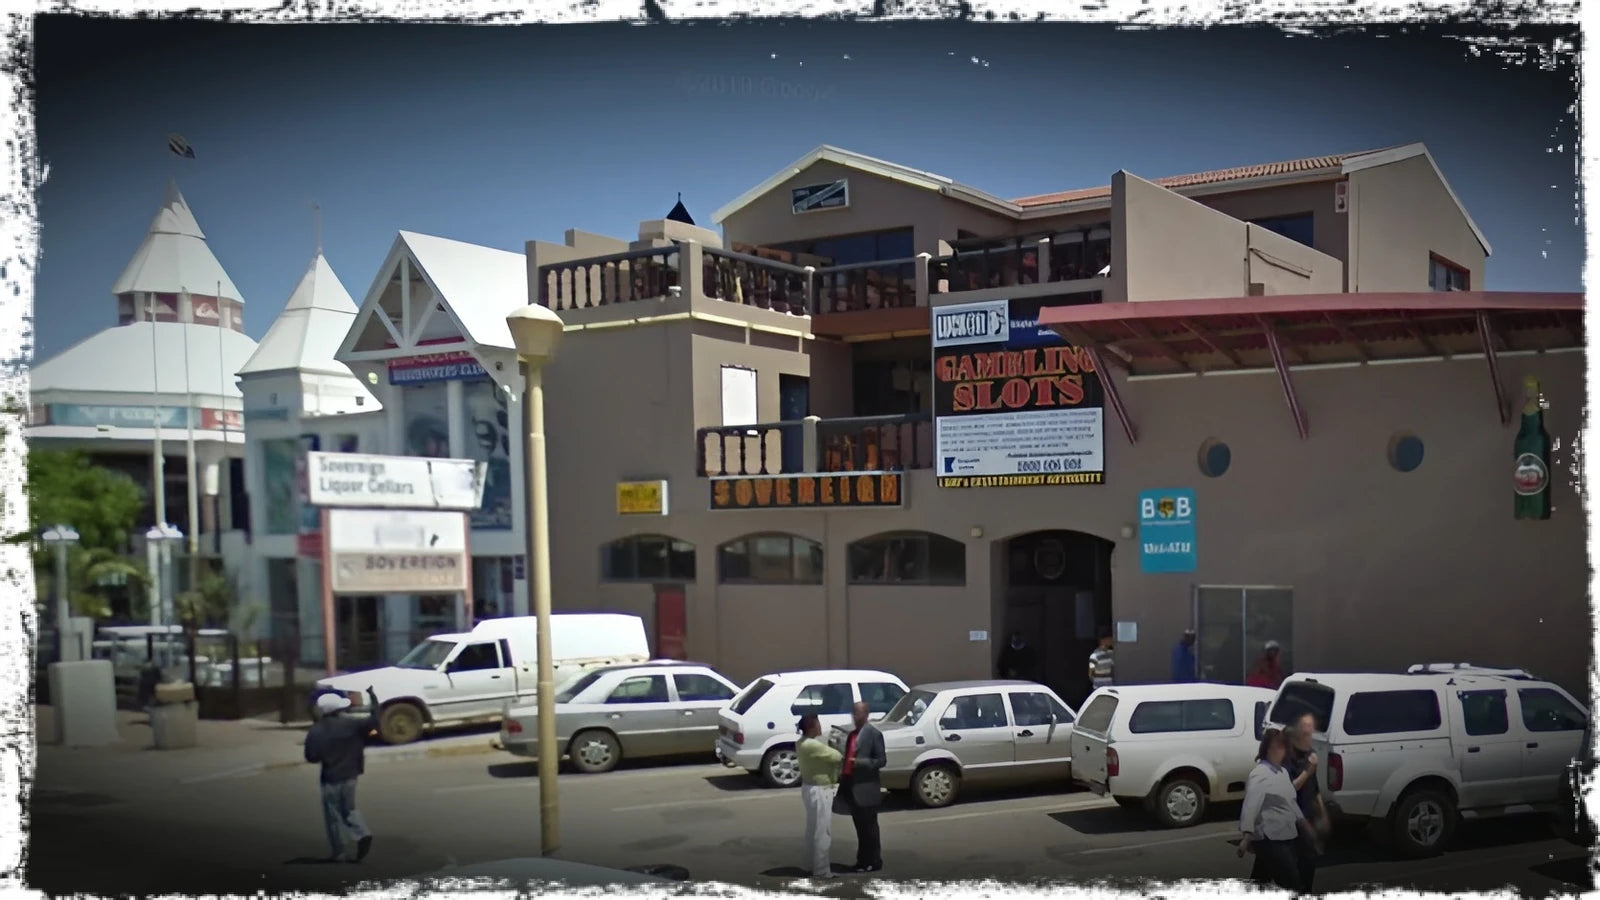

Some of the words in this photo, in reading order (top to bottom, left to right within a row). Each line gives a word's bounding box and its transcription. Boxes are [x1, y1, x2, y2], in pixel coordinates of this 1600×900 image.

[936, 346, 1095, 382] GAMBLING
[953, 374, 1085, 411] SLOTS
[318, 456, 386, 476] Sovereign
[319, 477, 363, 494] Liquor
[367, 478, 415, 494] Cellars
[713, 474, 898, 506] SOVEREIGN
[365, 555, 457, 570] SOVEREIGN
